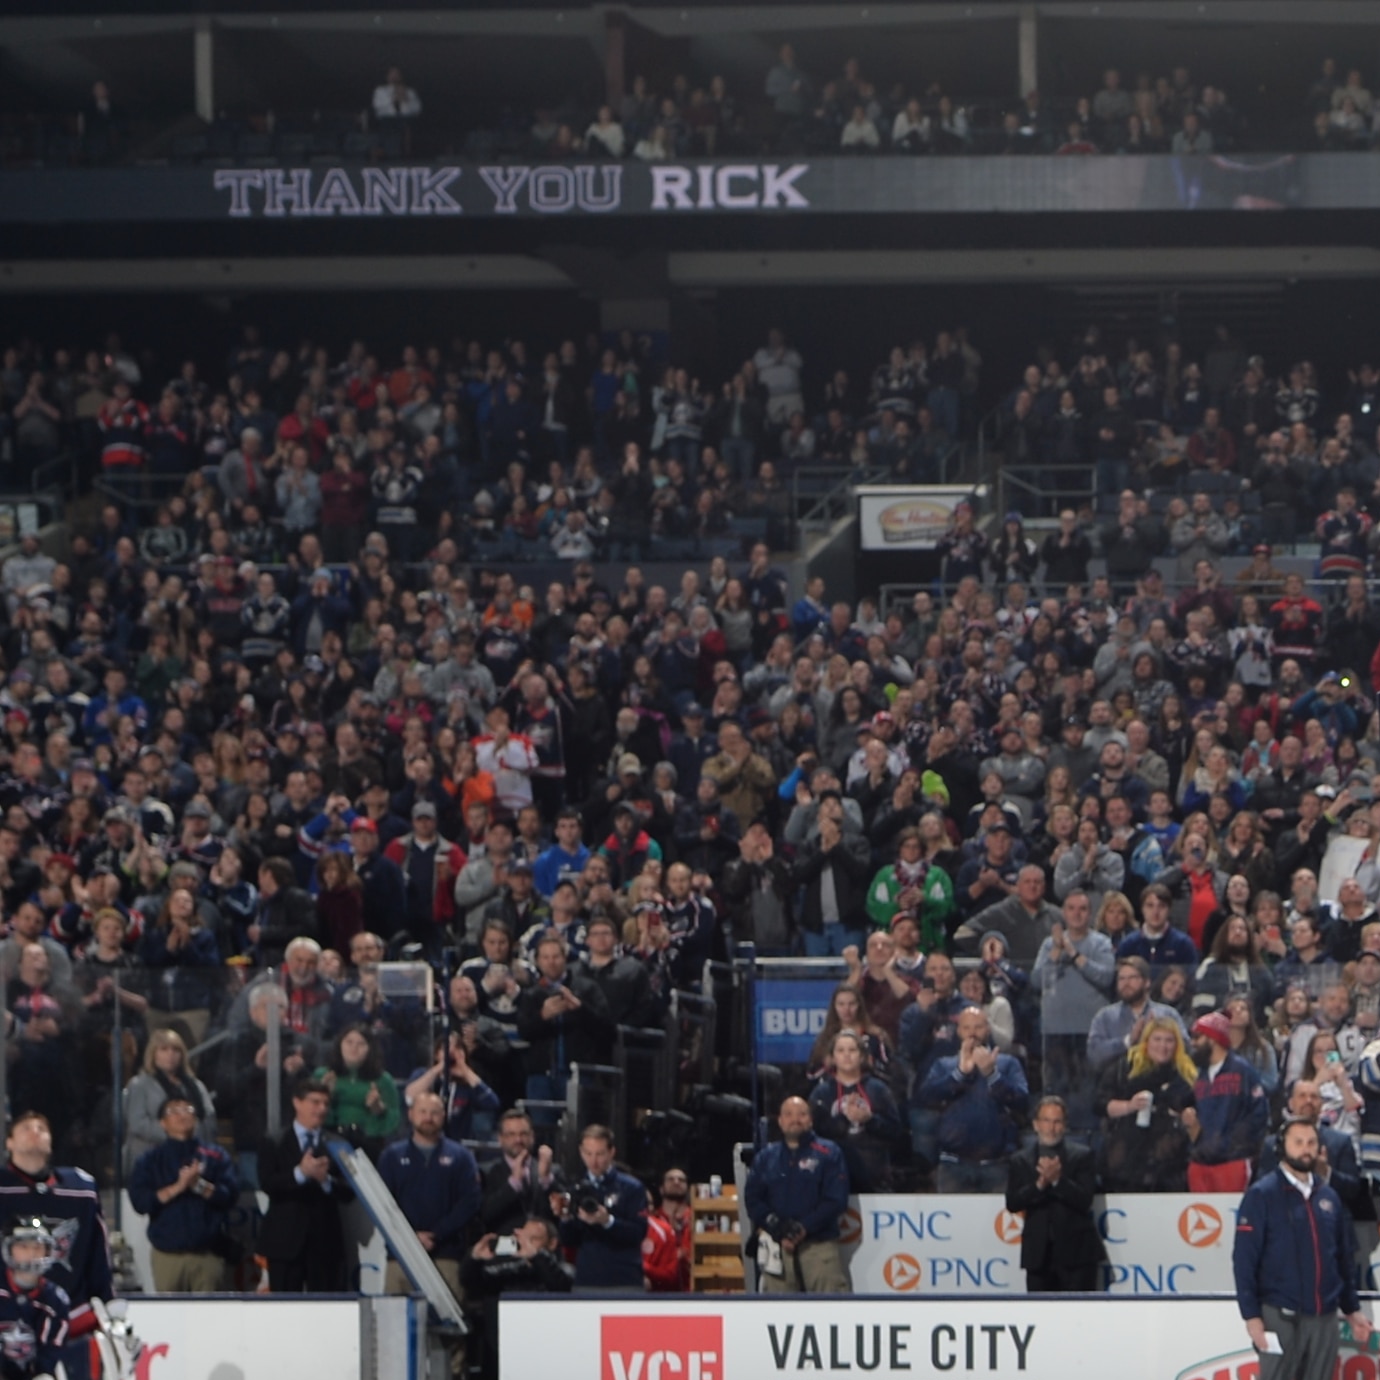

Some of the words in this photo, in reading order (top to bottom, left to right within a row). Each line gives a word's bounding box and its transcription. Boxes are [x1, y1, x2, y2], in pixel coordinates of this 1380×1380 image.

[213, 167, 462, 216] THANK
[479, 166, 621, 213] YOU
[649, 165, 809, 210] RICK
[762, 1008, 829, 1035] BUD
[870, 1210, 952, 1241] PNC
[928, 1256, 1010, 1288] PNC
[1103, 1263, 1196, 1292] PNC
[767, 1323, 912, 1371] VALUE
[930, 1323, 1036, 1371] CITY
